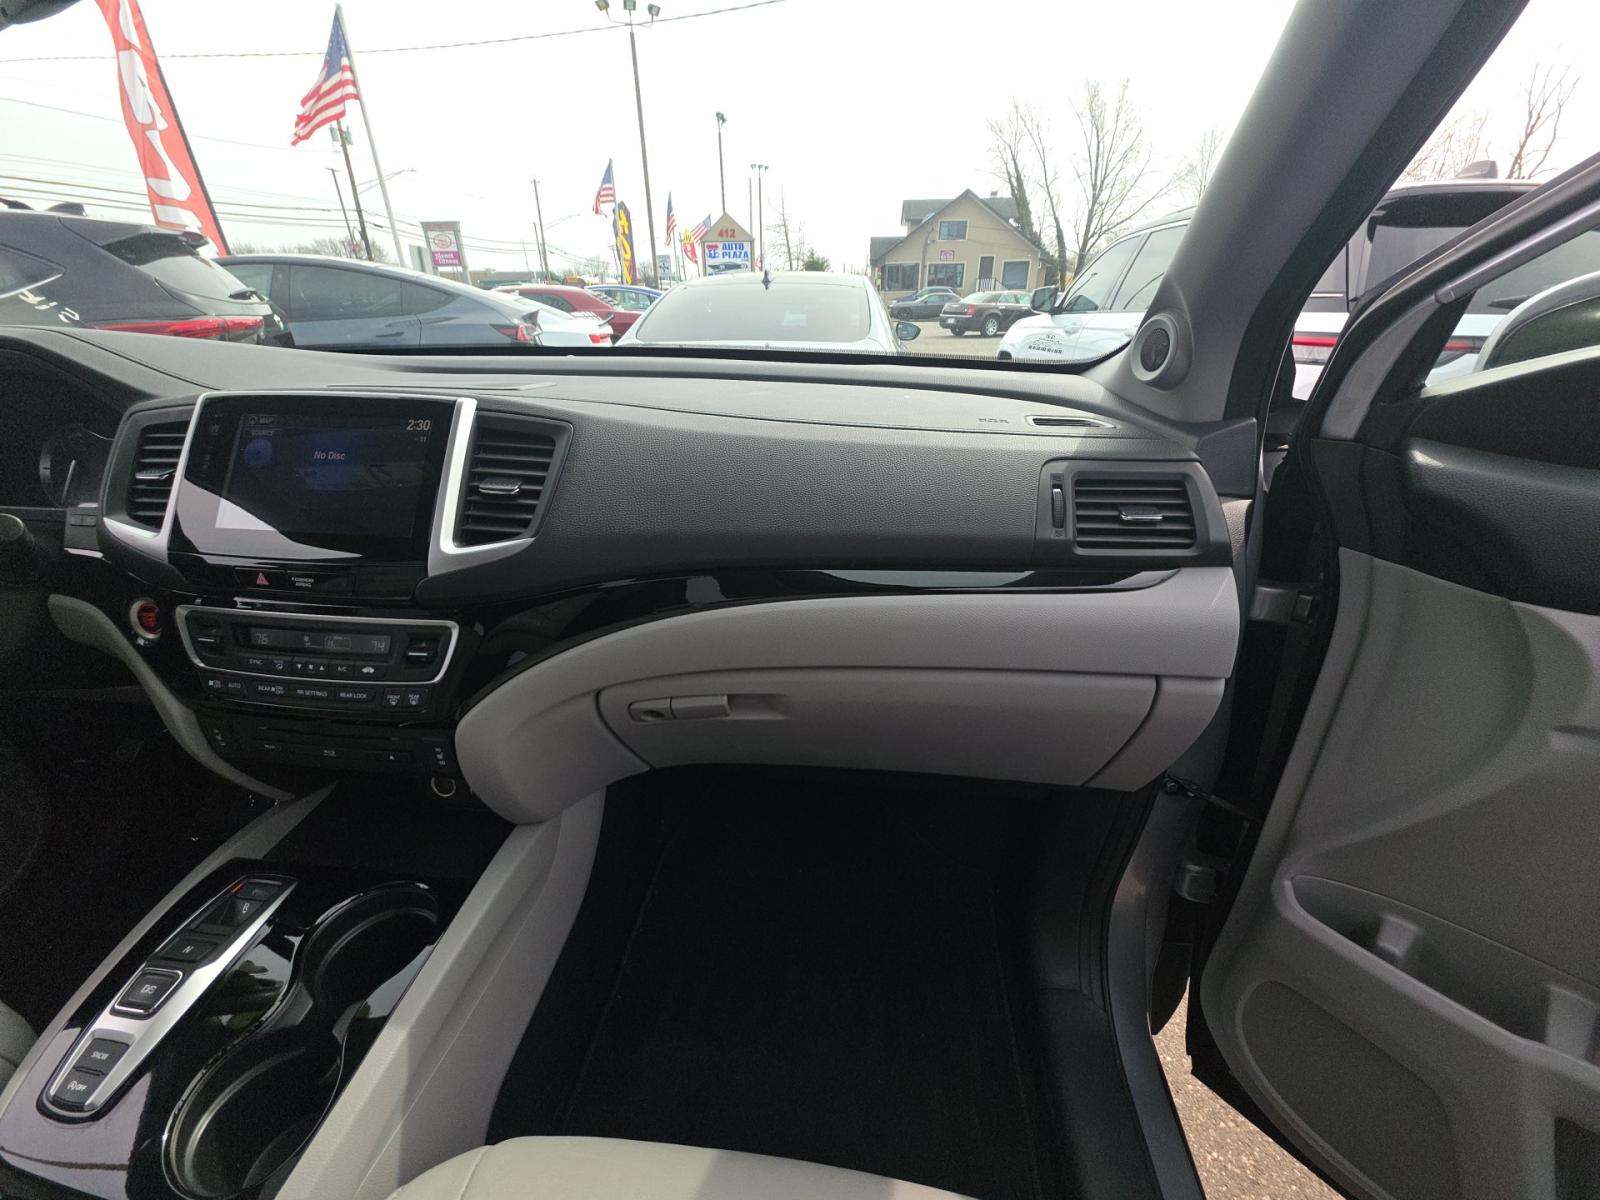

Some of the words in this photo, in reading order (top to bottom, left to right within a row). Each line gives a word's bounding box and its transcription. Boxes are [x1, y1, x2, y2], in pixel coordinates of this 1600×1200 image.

[718, 229, 736, 239] 412
[722, 242, 744, 250] AUTO
[407, 419, 431, 431] 2:30
[314, 450, 326, 460] No
[328, 451, 346, 461] Disc
[242, 902, 250, 914] R
[183, 945, 193, 953] N
